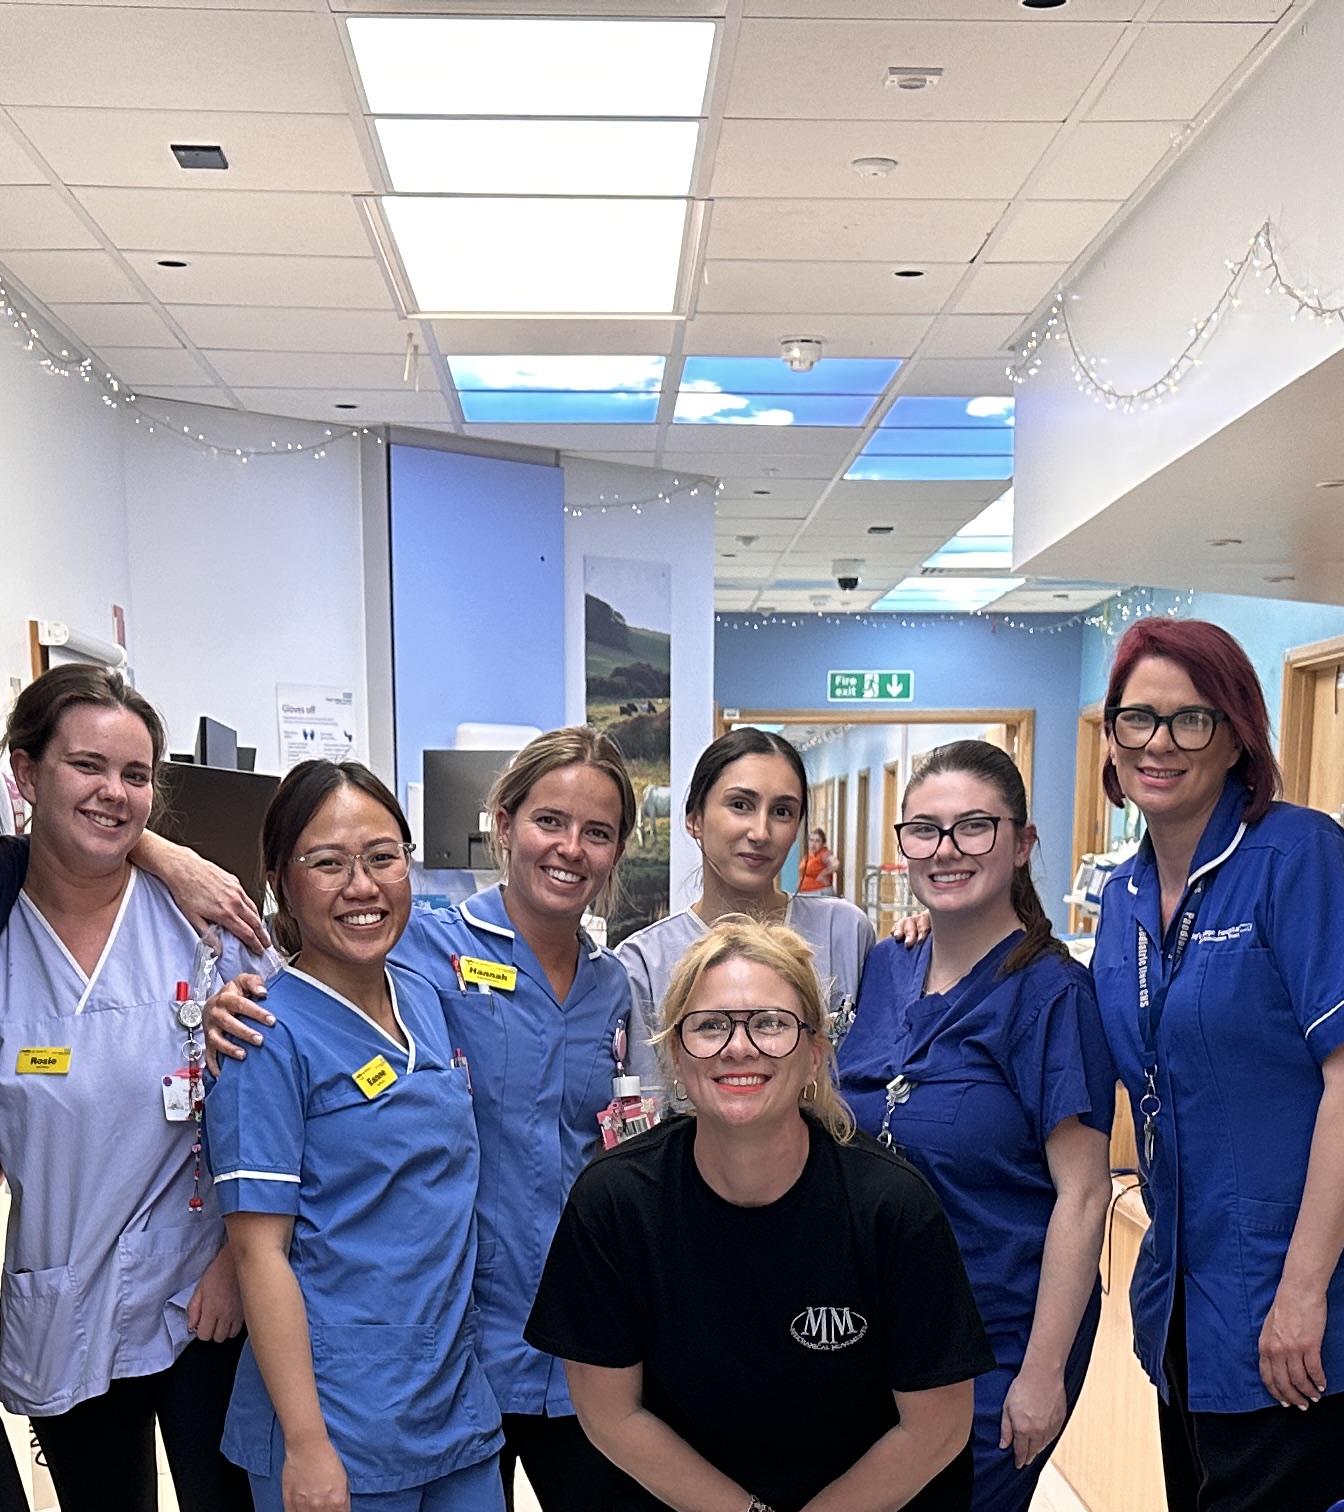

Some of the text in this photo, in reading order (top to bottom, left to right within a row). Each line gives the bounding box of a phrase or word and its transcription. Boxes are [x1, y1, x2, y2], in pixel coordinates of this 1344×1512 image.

[835, 675, 857, 685] Fire
[835, 686, 856, 696] exit
[469, 967, 508, 981] Hannah
[801, 1306, 858, 1345] MM
